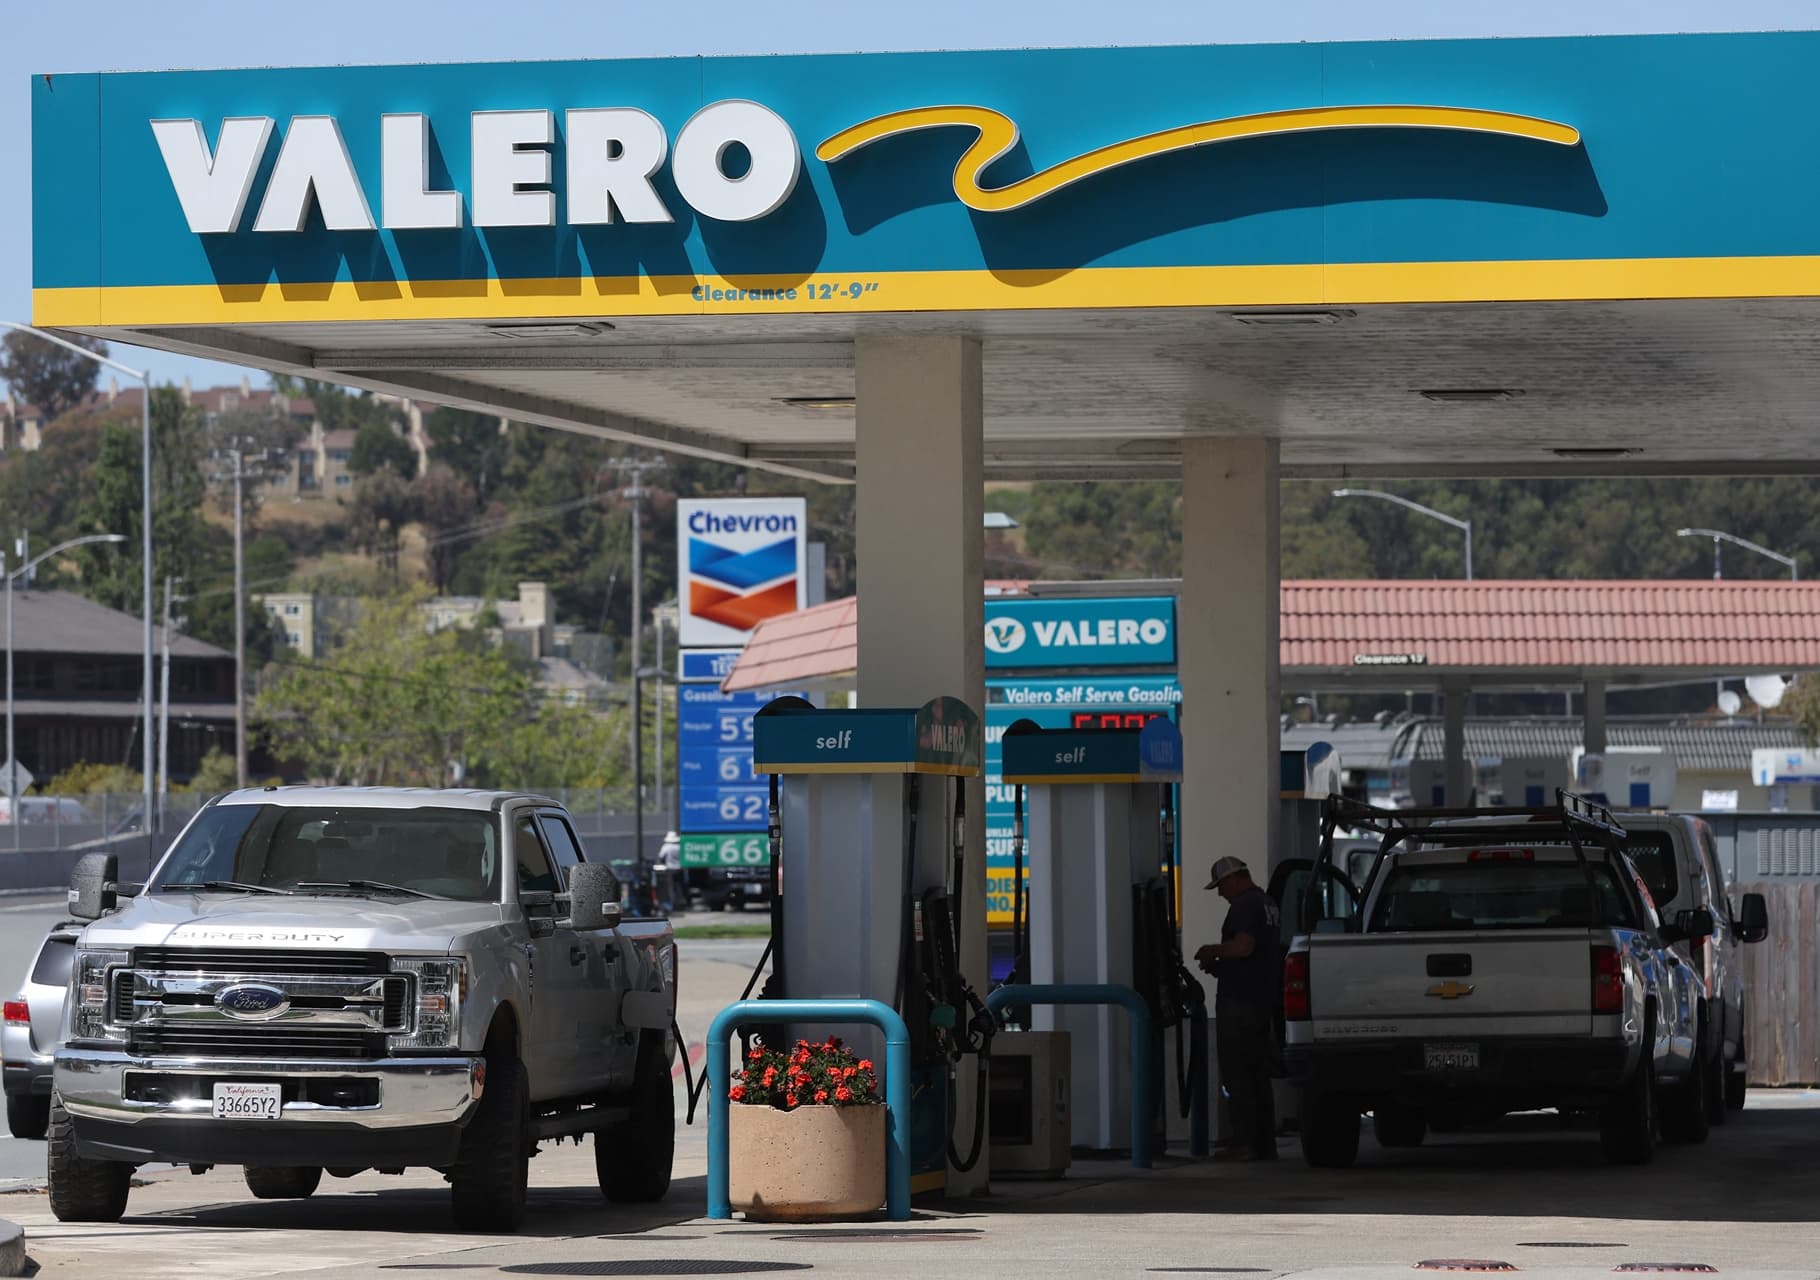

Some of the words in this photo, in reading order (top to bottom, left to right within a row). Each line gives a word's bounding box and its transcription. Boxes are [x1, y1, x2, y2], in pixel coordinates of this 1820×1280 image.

[149, 98, 801, 234] VALERO
[691, 285, 798, 302] Clearance
[688, 510, 798, 534] Chevron
[1031, 617, 1168, 648] VALERO
[1354, 654, 1408, 665] Clearance
[1005, 687, 1052, 704] Valero
[1055, 686, 1083, 703] Self
[1086, 687, 1124, 703] Serve
[815, 730, 852, 749] self
[930, 723, 966, 753] VALERO
[1055, 746, 1086, 764] self
[719, 795, 770, 821] 62
[719, 838, 770, 864] 66
[172, 930, 264, 941] SUPER
[272, 932, 346, 943] DUTY
[233, 991, 270, 1009] Ford
[217, 1096, 276, 1114] 33665Y2
